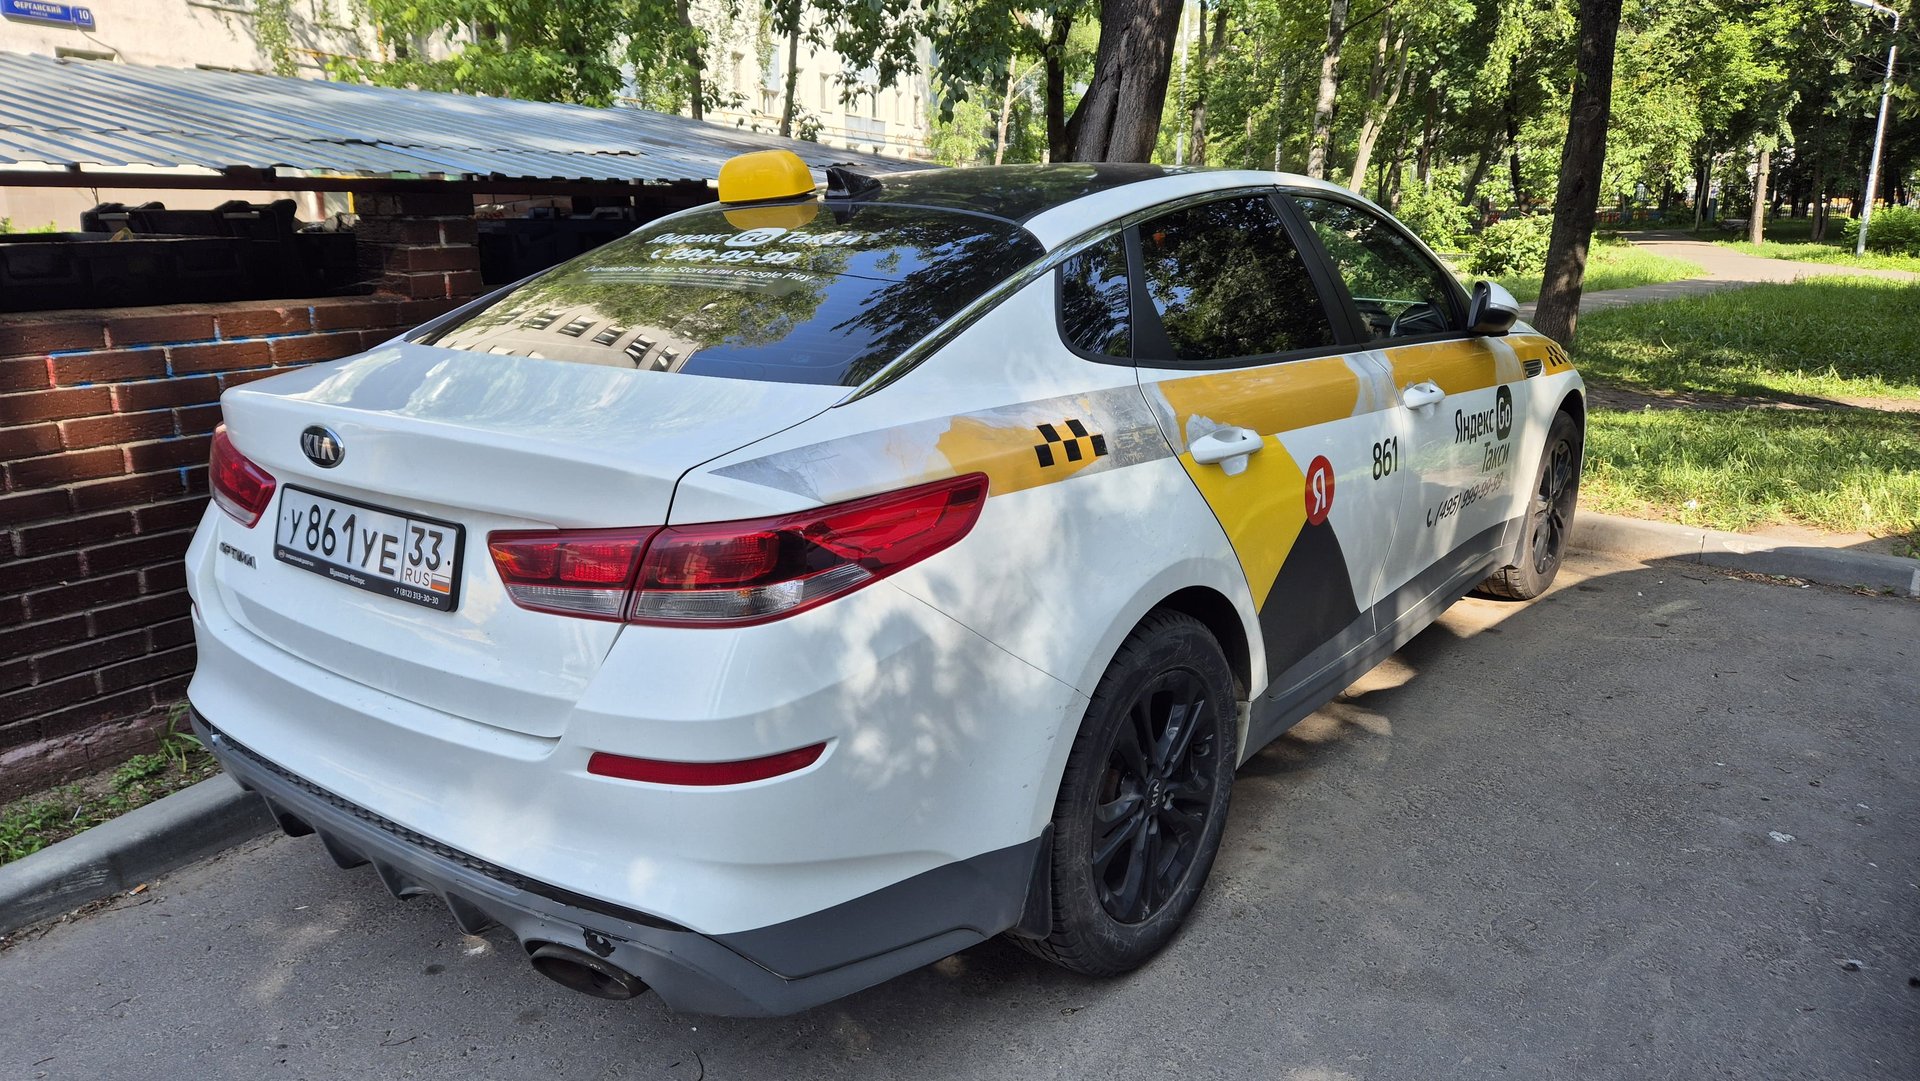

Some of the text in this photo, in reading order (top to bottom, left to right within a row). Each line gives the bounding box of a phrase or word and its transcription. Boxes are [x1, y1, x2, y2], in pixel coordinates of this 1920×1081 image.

[13, 0, 62, 13] ФЕРГАНСКИЙ
[79, 9, 89, 20] 10
[645, 232, 732, 245] Яндекс
[779, 231, 863, 246] Такси
[662, 248, 801, 264] 999-99-99
[734, 268, 782, 279] Google
[782, 272, 816, 281] Play
[1455, 394, 1512, 444] Яндекс Go
[303, 432, 336, 461] KIA
[1372, 435, 1398, 481] 861
[1481, 441, 1511, 474] Такси
[1312, 467, 1327, 516] Я
[1434, 471, 1504, 526] (495) 999-99-99
[408, 525, 443, 571] 33
[404, 567, 430, 587] RUS
